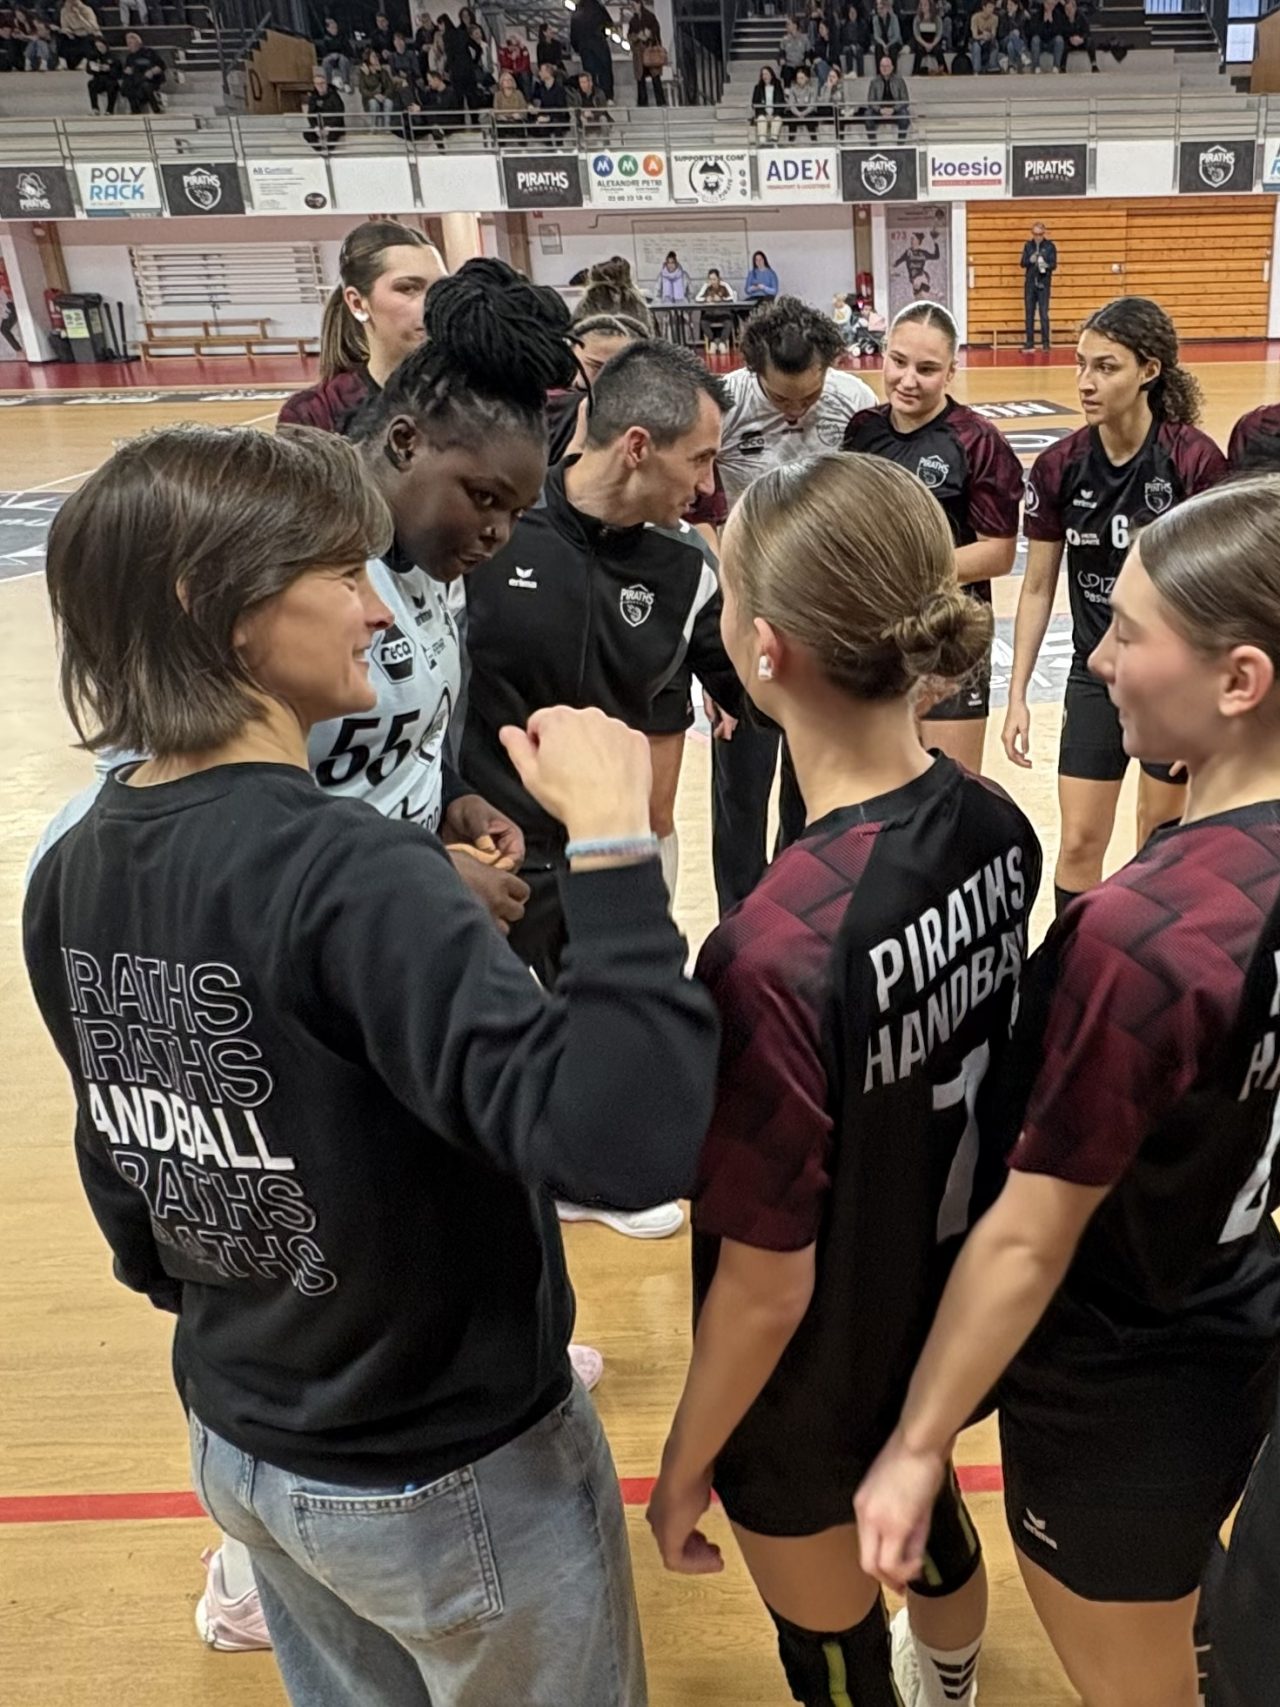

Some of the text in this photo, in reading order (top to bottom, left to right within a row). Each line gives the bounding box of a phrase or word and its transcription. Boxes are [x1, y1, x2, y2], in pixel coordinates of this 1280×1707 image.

[861, 160, 897, 173] PIRATHS
[931, 156, 1002, 177] koesio
[1200, 152, 1235, 164] PIRATHS
[91, 167, 146, 183] POLY
[766, 159, 830, 182] ADEX
[1024, 159, 1076, 178] PIRATHS
[182, 174, 221, 188] PIRATHS
[516, 171, 569, 190] PIRATHS
[89, 184, 146, 200] RACK
[1111, 514, 1130, 549] 6
[508, 578, 537, 589] erima
[620, 588, 654, 605] PIRATHS
[315, 709, 420, 787] 55
[868, 845, 1026, 1013] PIRATHS
[932, 1039, 990, 1243] 7
